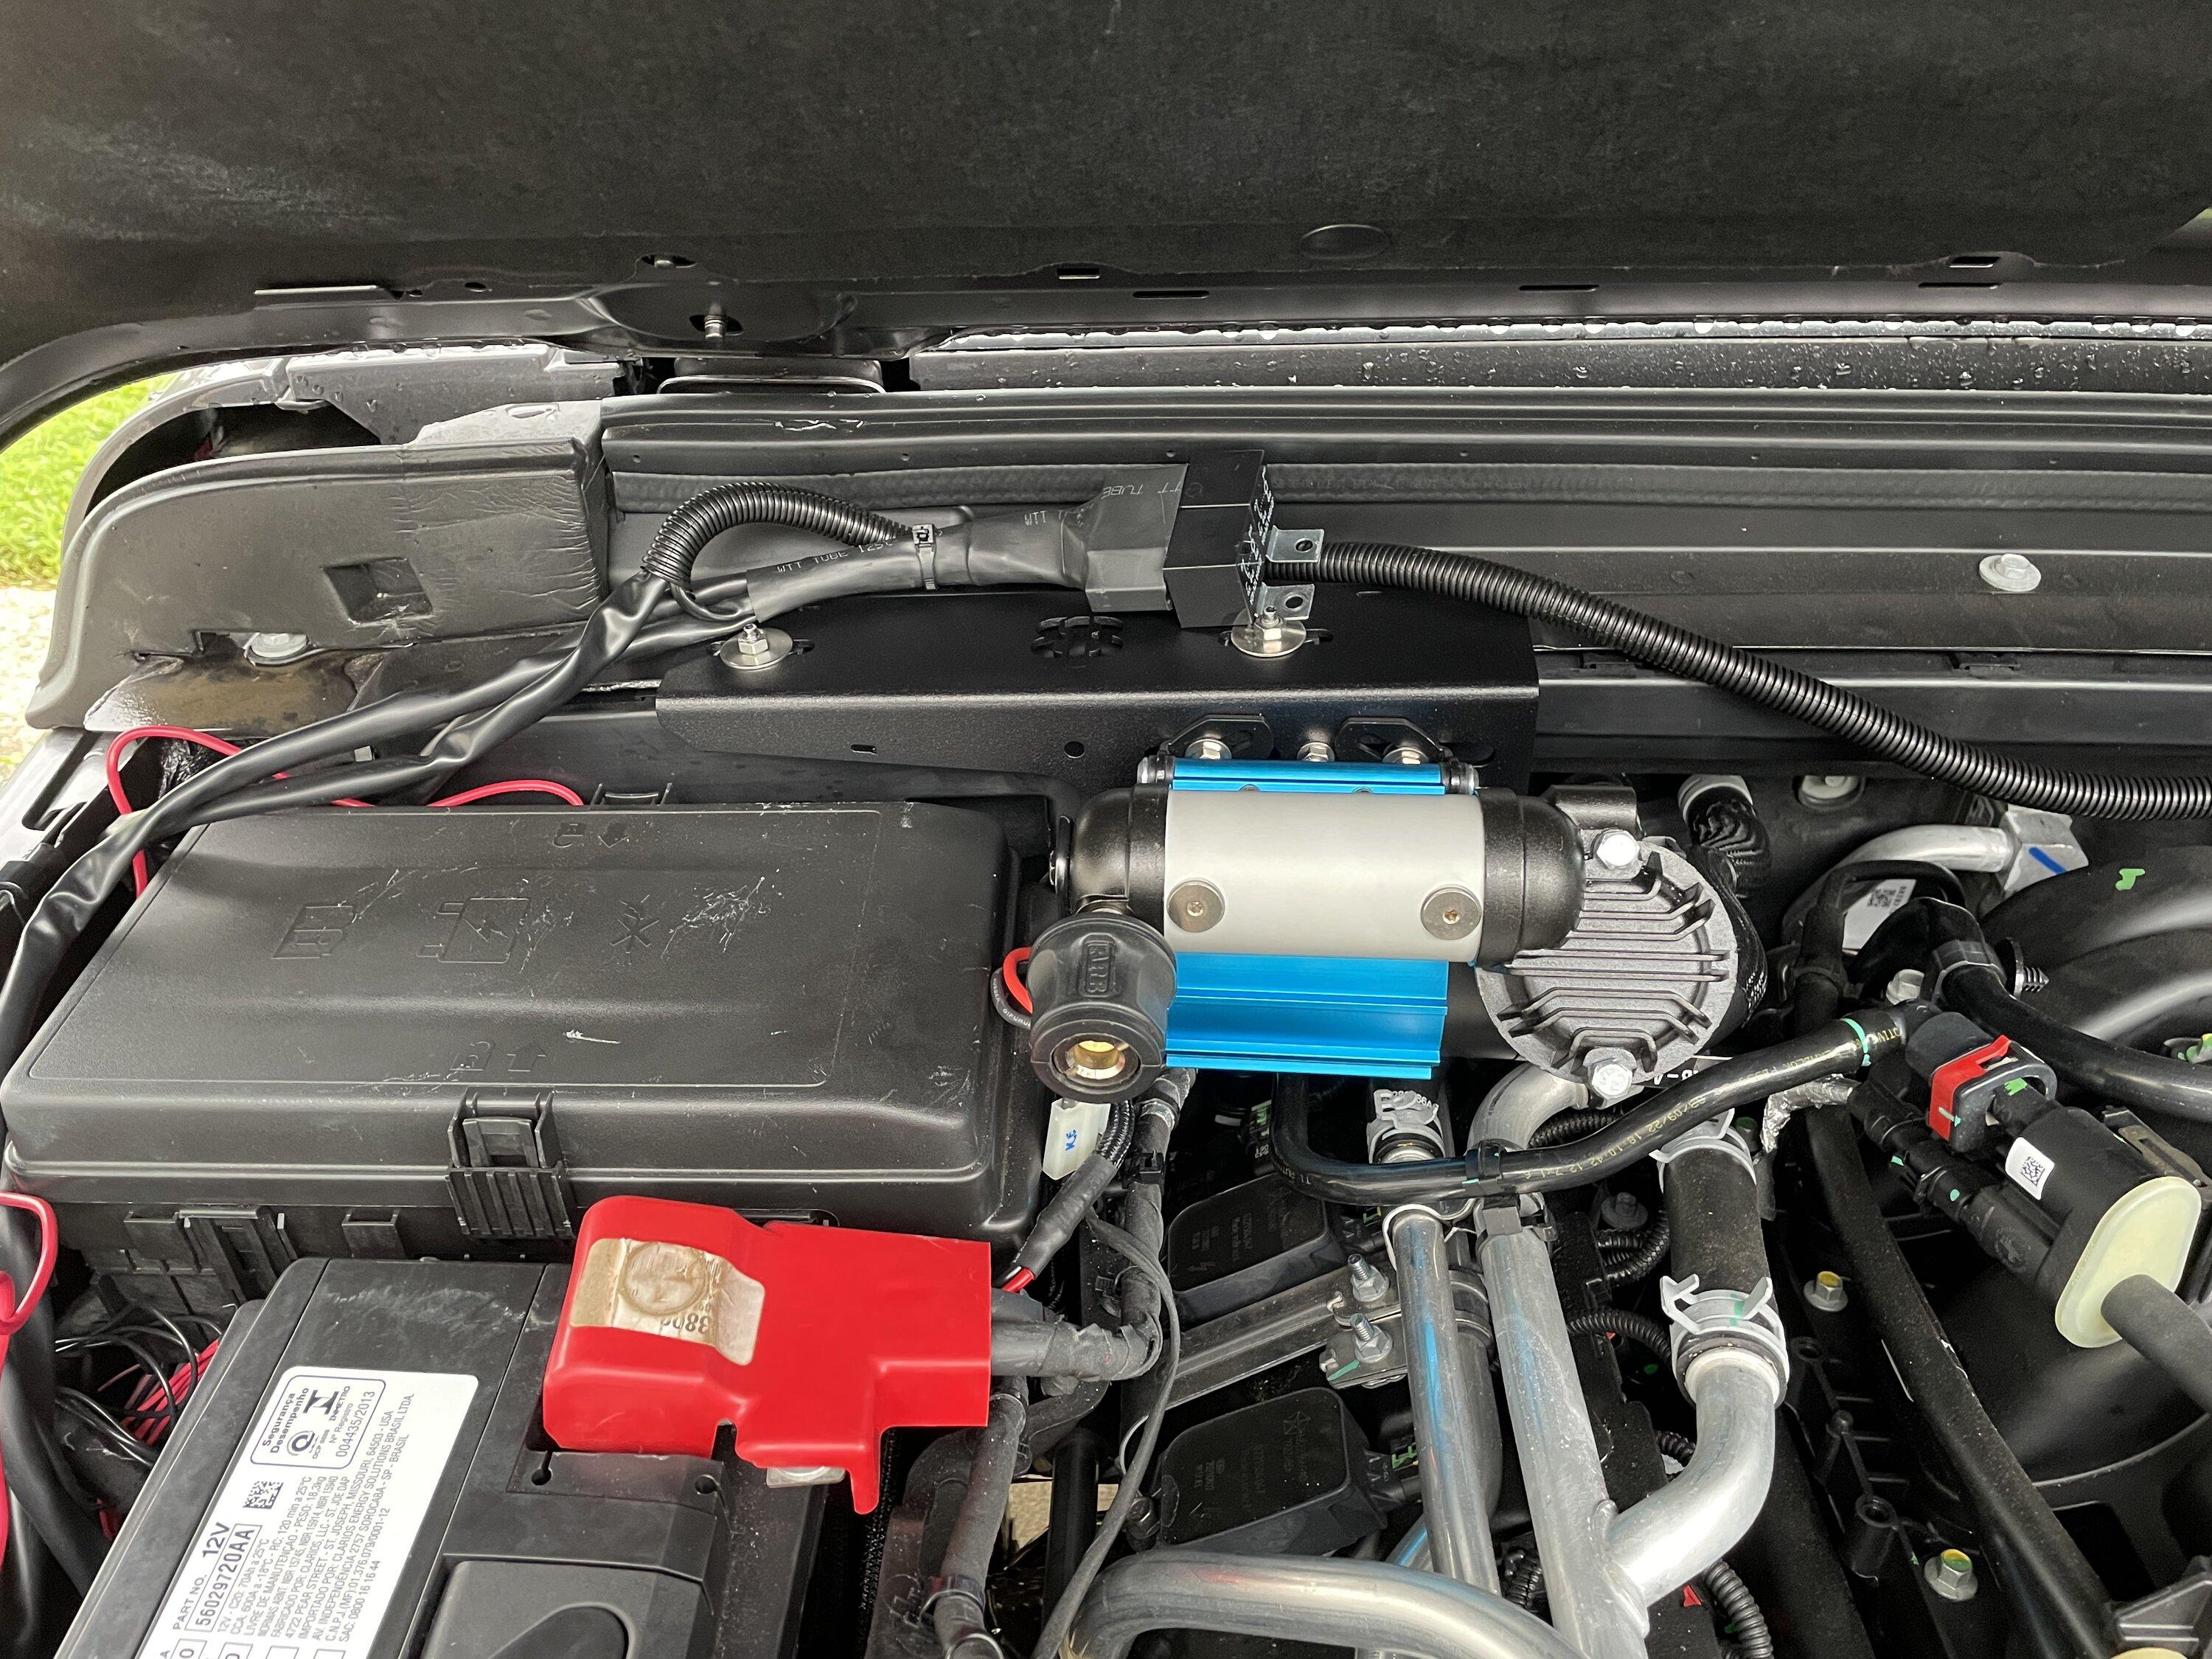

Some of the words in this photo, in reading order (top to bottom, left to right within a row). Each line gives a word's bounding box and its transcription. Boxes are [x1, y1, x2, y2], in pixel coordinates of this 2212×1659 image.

[776, 561, 802, 573] WTT
[262, 1393, 296, 1446] Segurança
[270, 1388, 309, 1453] Desempenho
[329, 1385, 350, 1422] INMETRO
[333, 1402, 353, 1433] Registro
[335, 1391, 375, 1457] 004435/2013
[331, 1492, 344, 1506] JOE
[336, 1476, 350, 1492] DAP
[277, 1520, 292, 1534] 120
[286, 1503, 300, 1518] min
[285, 1617, 302, 1638] 4722
[294, 1592, 313, 1615] PEAR
[306, 1557, 328, 1590] STREET
[323, 1538, 338, 1550] ST.
[331, 1502, 355, 1536] JOSEPH,
[346, 1458, 374, 1500] MISSOURI,
[366, 1433, 384, 1456] 64503
[379, 1411, 394, 1427] USA
[298, 1586, 329, 1639] IMPORTADO
[332, 1525, 356, 1562] CLARIOS
[349, 1490, 370, 1523] ENERGY
[364, 1444, 392, 1489] SOLUTIONS
[384, 1416, 405, 1443] BRASIL
[397, 1394, 414, 1414] LTDA.
[315, 1523, 330, 1537] LLC
[319, 1555, 356, 1624] INDEPENDÊNCIA
[349, 1533, 365, 1554] 2757
[358, 1486, 386, 1531] SOROCABA
[389, 1434, 409, 1462] BRASIL
[202, 1522, 230, 1557] 12V
[281, 1570, 296, 1585] NBR
[298, 1532, 313, 1546] NBR
[316, 1495, 330, 1509] NBR
[299, 1539, 324, 1573] CLARIOS,
[195, 1530, 254, 1625] 56029720AA
[243, 1610, 264, 1636] LIVRE
[293, 1503, 313, 1528] PESO:
[173, 1598, 194, 1630] PART
[189, 1574, 207, 1595] NO.
[270, 1594, 298, 1638] FABRICADO
[348, 1598, 366, 1619] 0800
